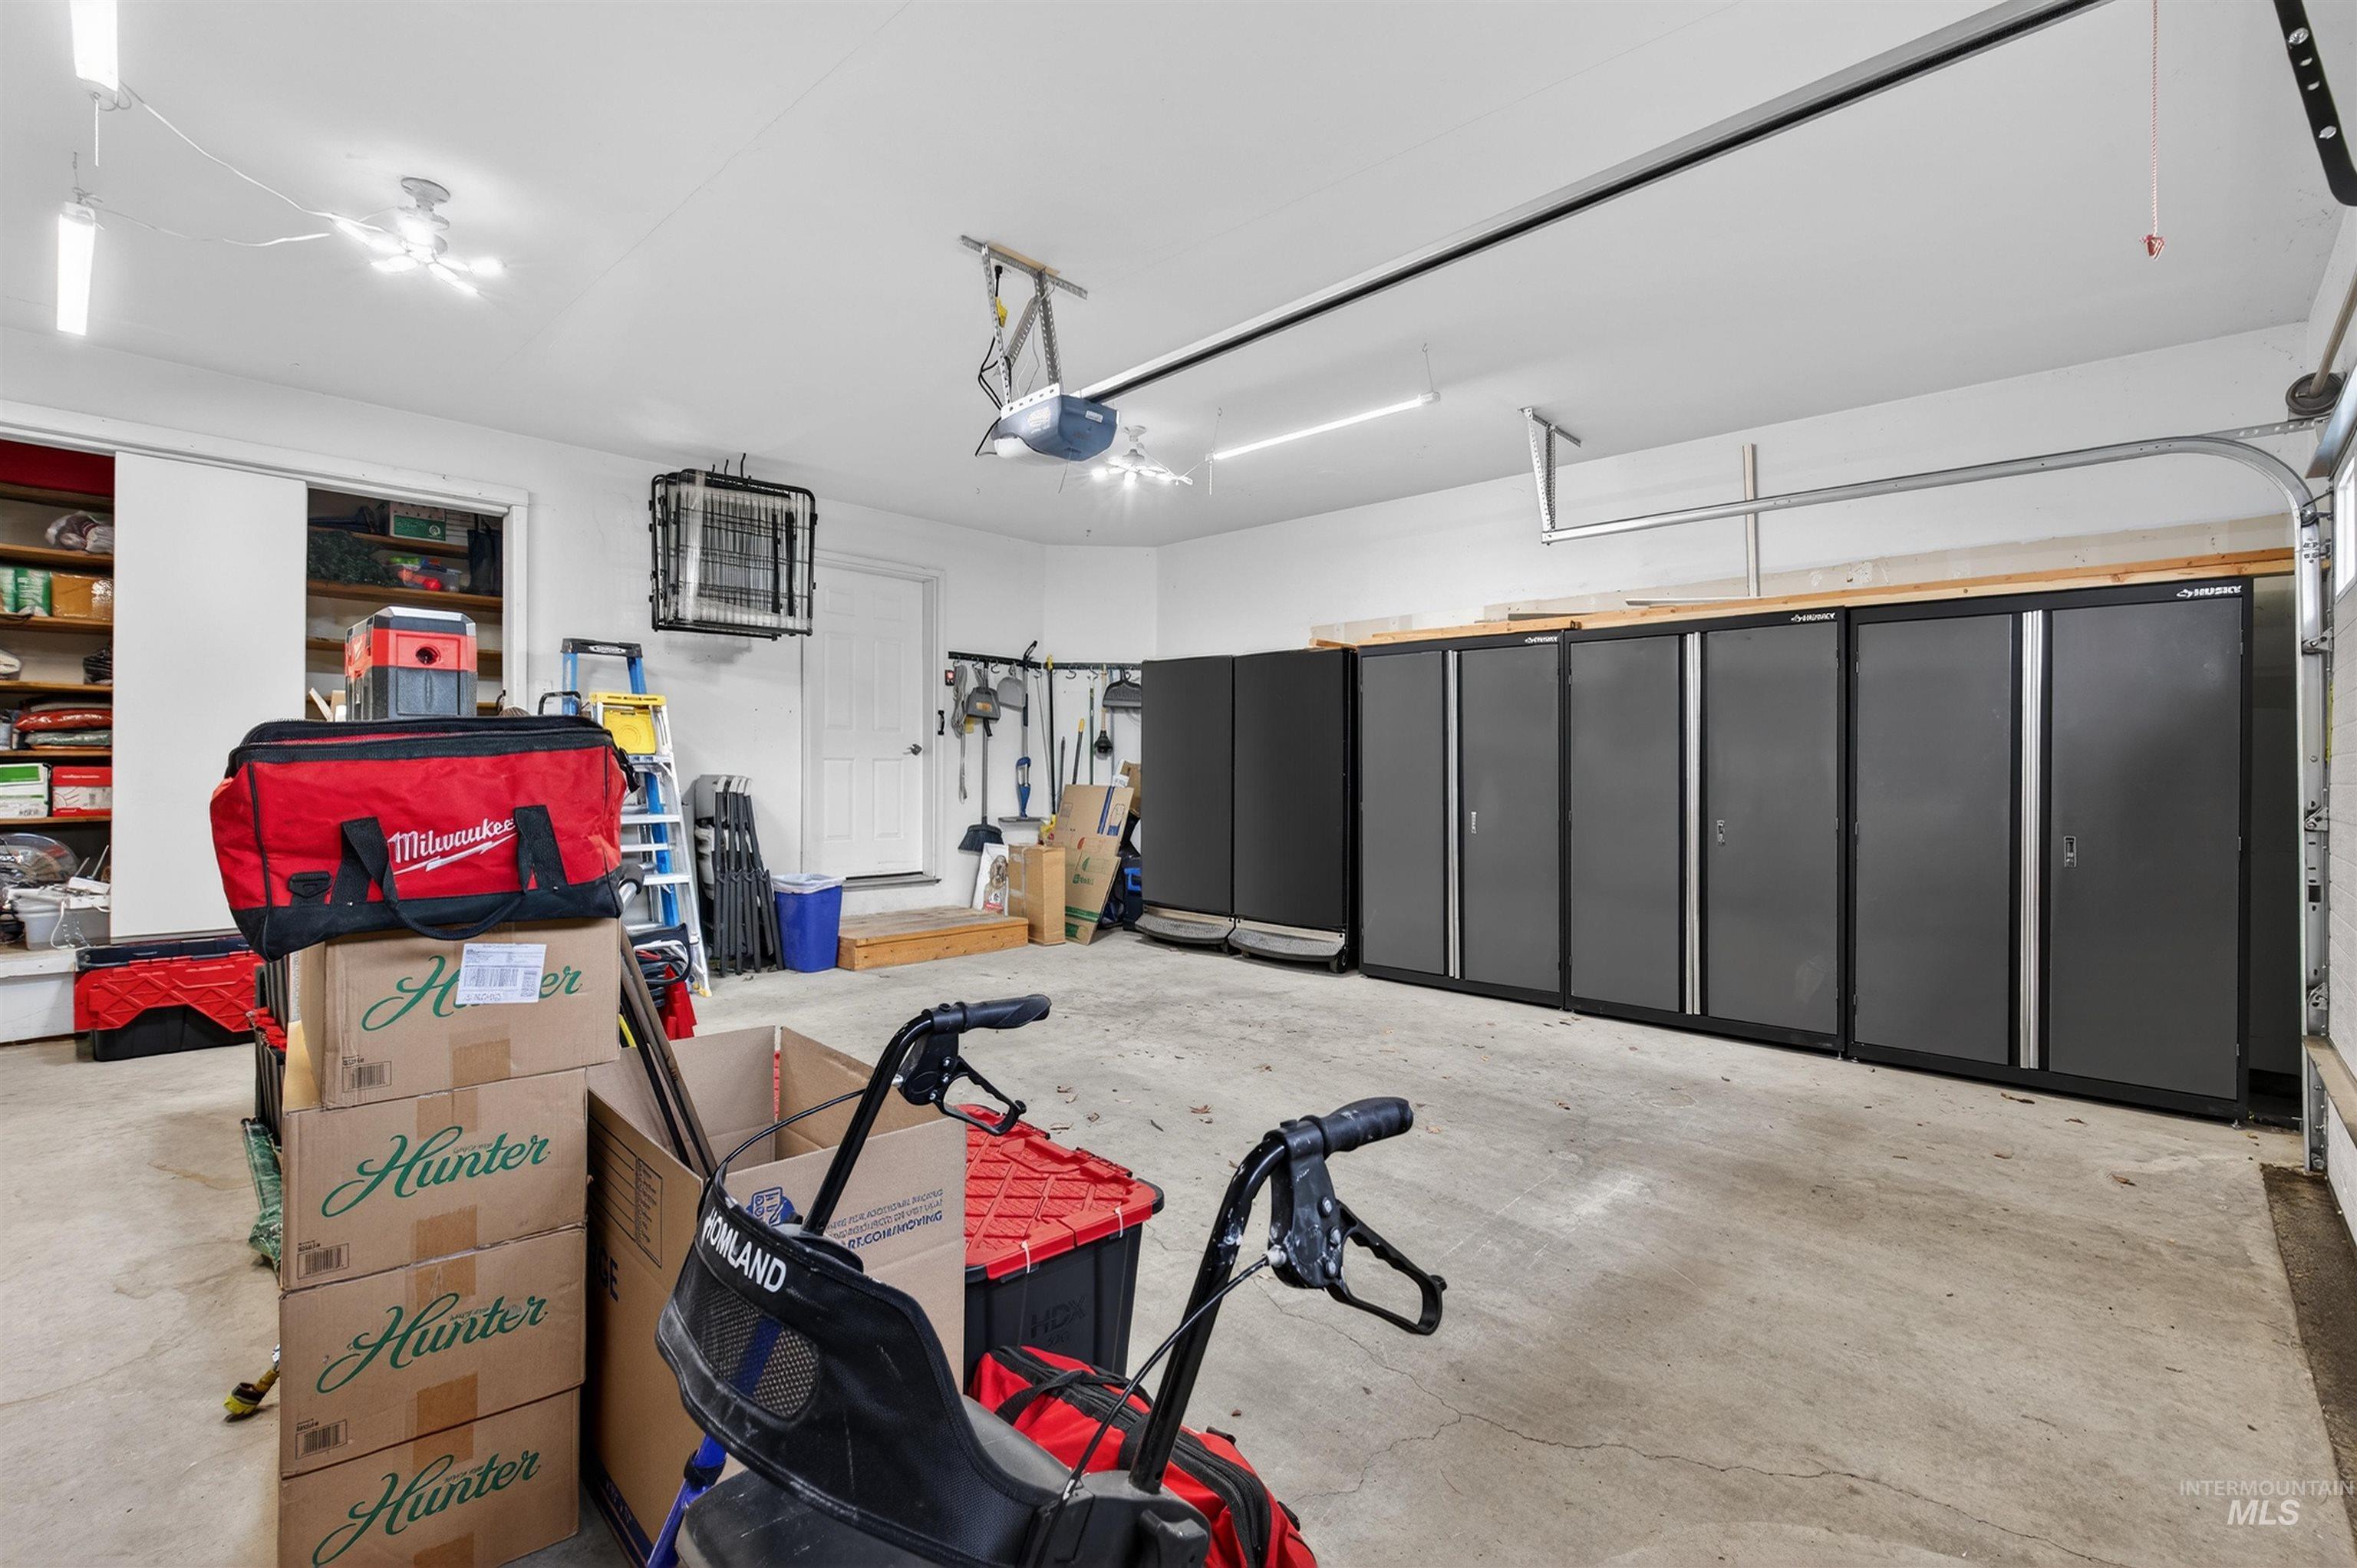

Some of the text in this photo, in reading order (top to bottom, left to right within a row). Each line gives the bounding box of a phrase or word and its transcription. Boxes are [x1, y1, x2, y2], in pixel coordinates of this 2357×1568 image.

[387, 818, 516, 864] Milwaukee
[321, 1125, 550, 1218] Hunter
[701, 1206, 787, 1293] HOMLAND
[315, 1292, 548, 1395] Hunter
[312, 1450, 541, 1568] Hunter
